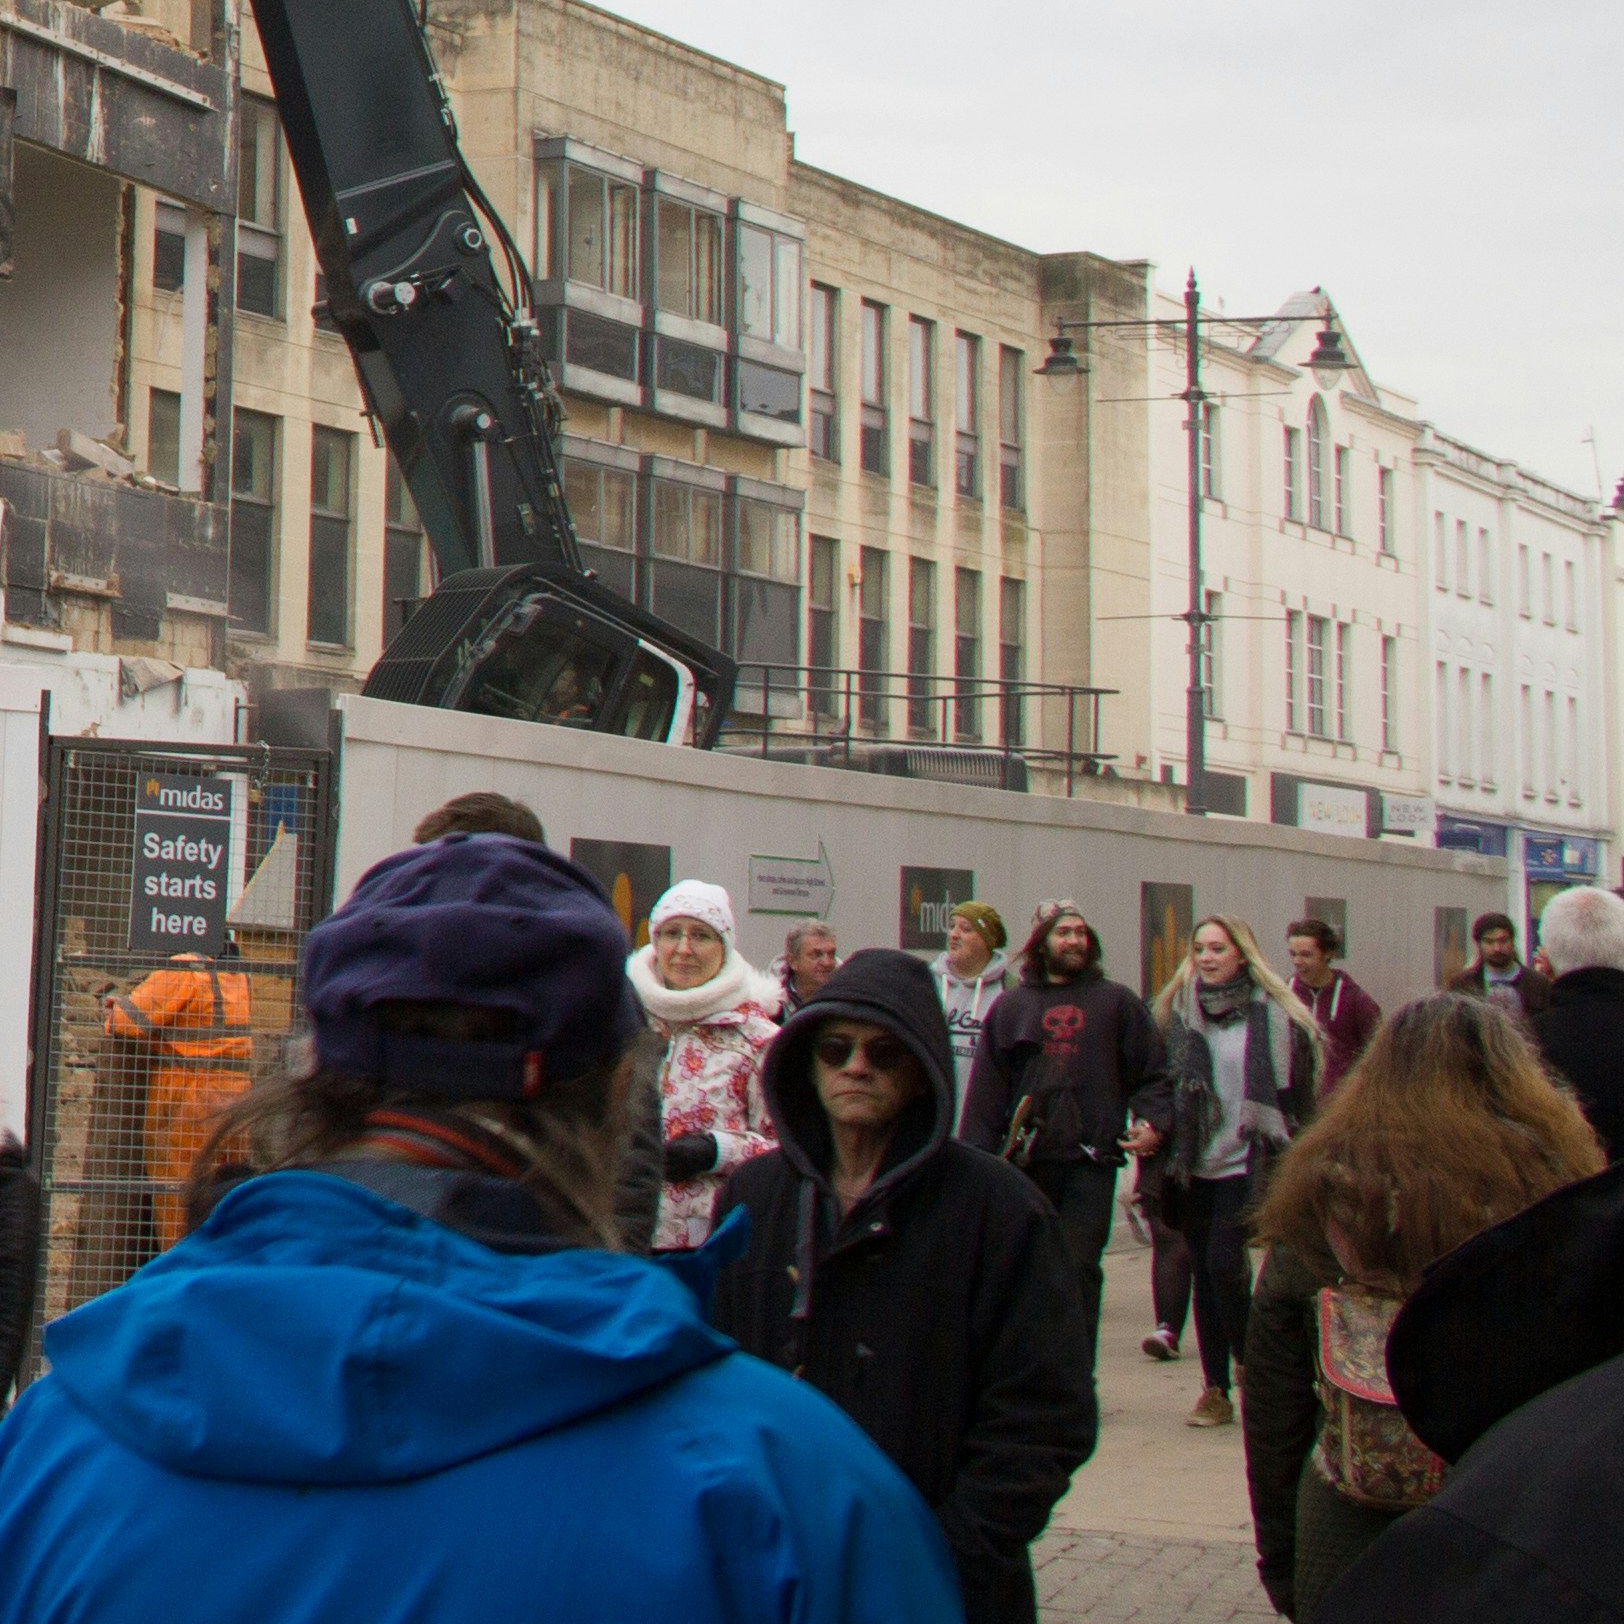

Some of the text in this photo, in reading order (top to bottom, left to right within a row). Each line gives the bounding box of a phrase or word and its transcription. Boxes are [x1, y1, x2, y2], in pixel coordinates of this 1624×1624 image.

[159, 785, 224, 810] midas
[1389, 803, 1424, 813] NEW
[142, 832, 224, 869] Safety
[144, 872, 218, 900] starts
[151, 907, 208, 936] here
[919, 889, 951, 934] mid
